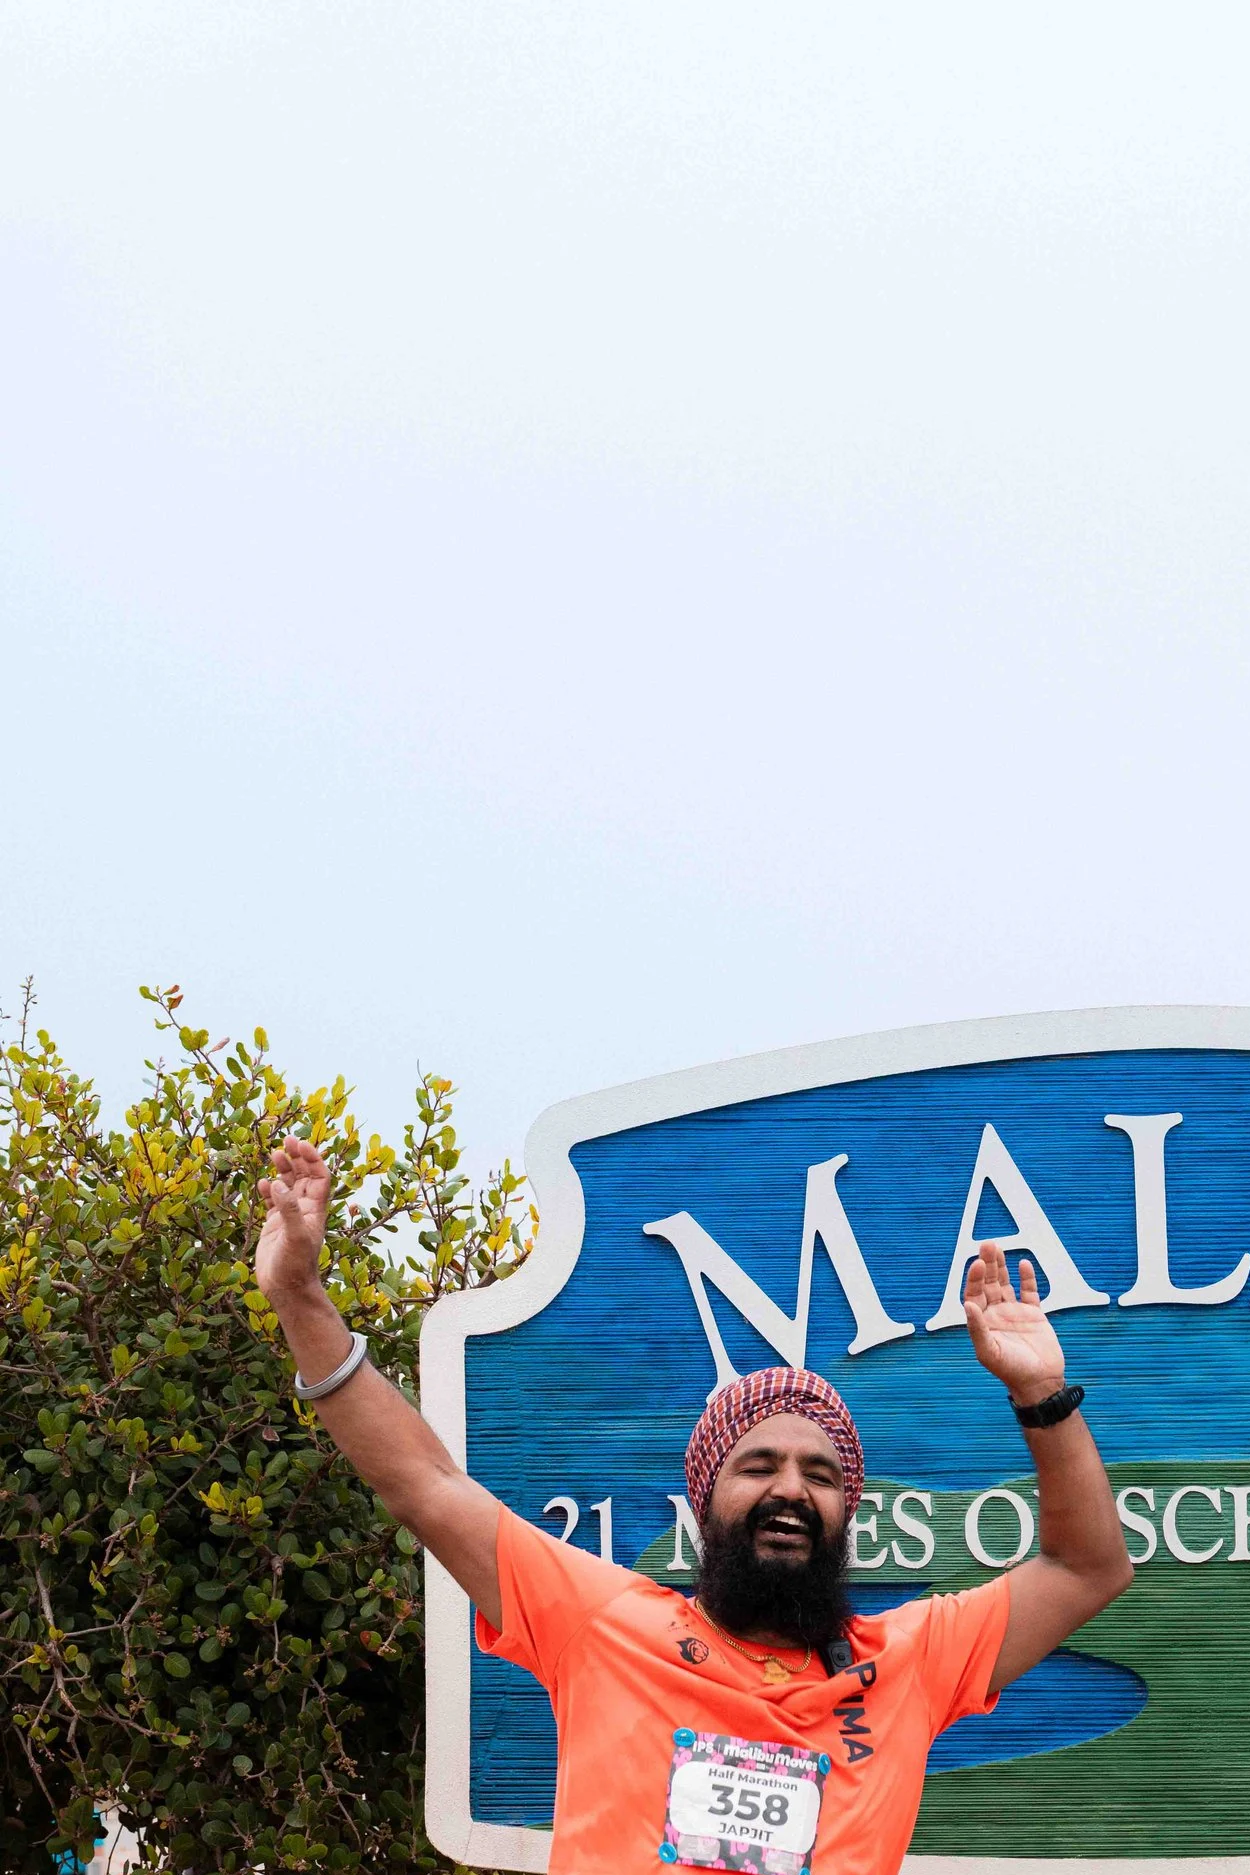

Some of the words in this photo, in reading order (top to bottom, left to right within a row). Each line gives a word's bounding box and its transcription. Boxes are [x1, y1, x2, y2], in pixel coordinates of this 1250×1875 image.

[542, 1495, 623, 1568] 21
[666, 1490, 935, 1570] MES
[964, 1488, 1040, 1568] O
[692, 1740, 714, 1754] IPS
[708, 1767, 735, 1781] Half
[738, 1772, 799, 1792] Marathon
[707, 1783, 790, 1827] 358
[717, 1821, 775, 1843] JAPJIT
